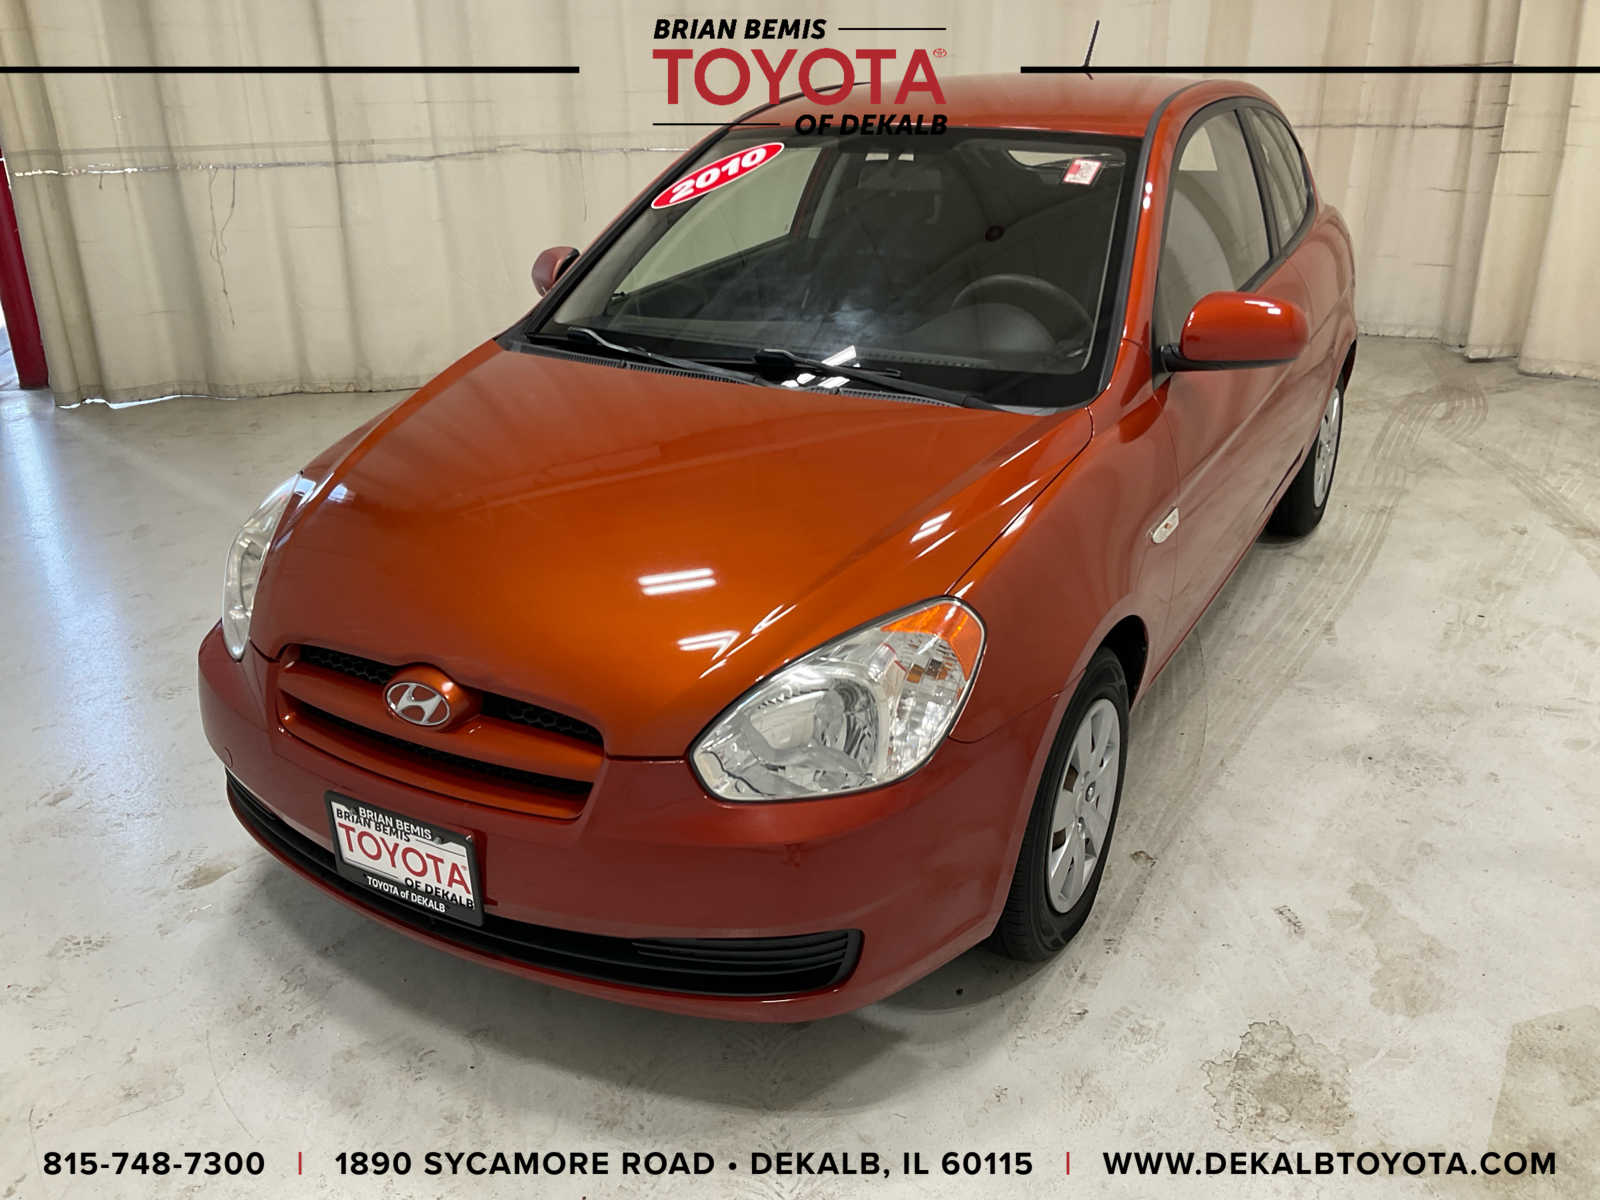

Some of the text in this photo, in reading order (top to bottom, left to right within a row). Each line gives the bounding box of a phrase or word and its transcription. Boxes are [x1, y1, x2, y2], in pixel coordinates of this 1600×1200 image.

[668, 147, 767, 204] 2010
[336, 807, 410, 842] BRIAN BEMIS
[358, 806, 432, 840] BRIAN BEMIS
[338, 822, 472, 895] TOYOTA
[366, 875, 446, 913] TOYOTA of DEKALB
[404, 877, 475, 909] OF DEKALB
